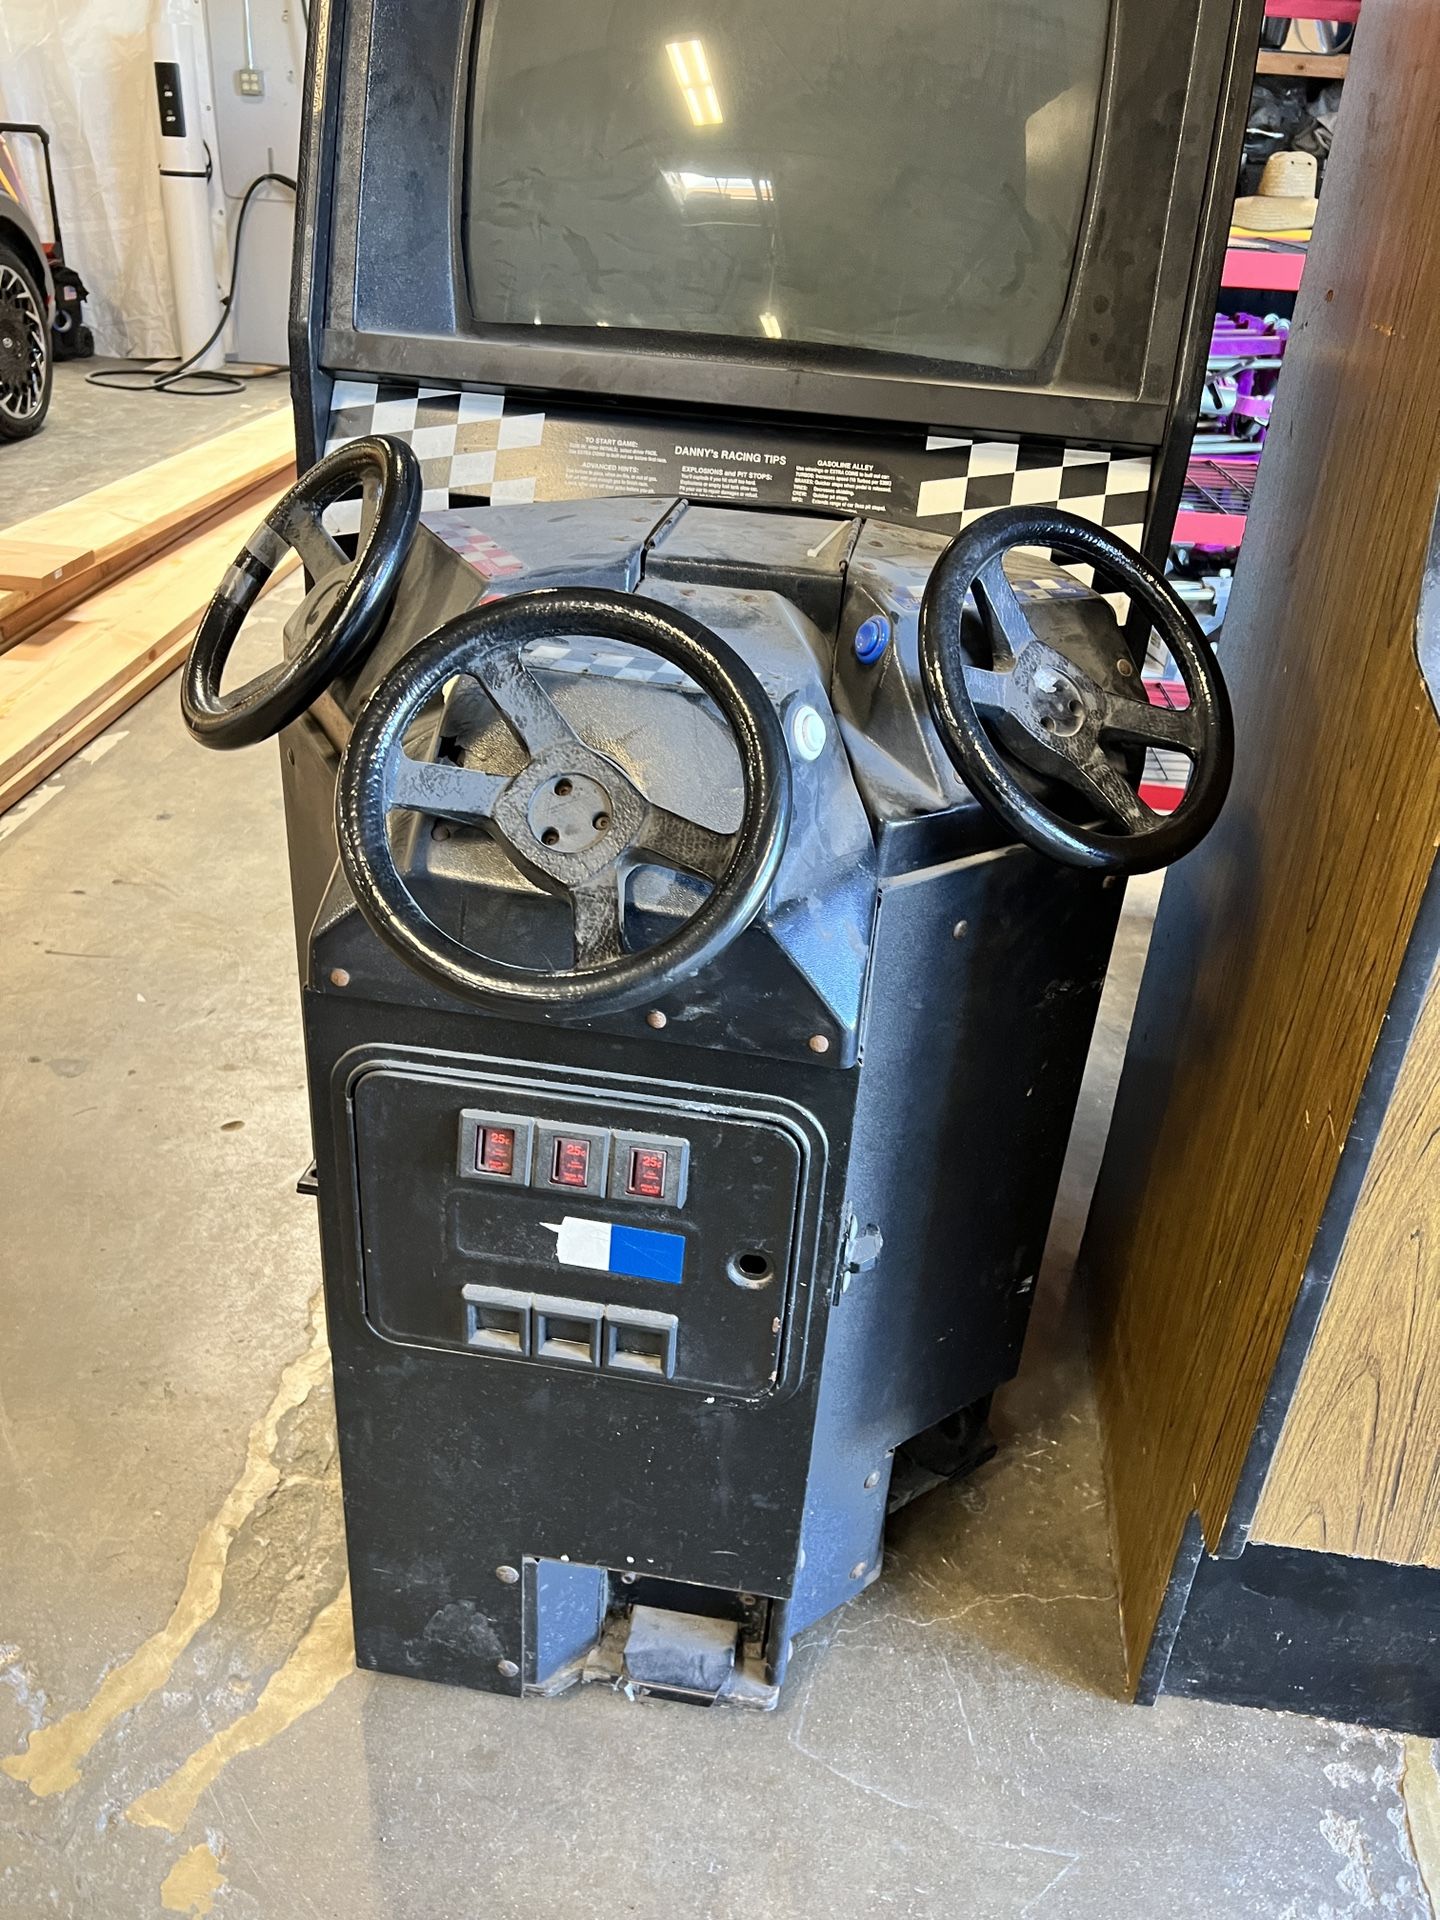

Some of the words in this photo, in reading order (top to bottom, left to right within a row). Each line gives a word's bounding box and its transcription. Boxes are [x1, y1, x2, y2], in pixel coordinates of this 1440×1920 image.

[674, 445, 719, 459] DANNY's
[721, 450, 761, 462] RACING
[764, 454, 787, 465] TIPS
[582, 462, 617, 471] ADVANCED
[617, 465, 639, 473] HINTS:
[817, 460, 851, 469] GASOLINE
[682, 466, 723, 475] EXPLOSIONS
[748, 472, 772, 480] STOPS:
